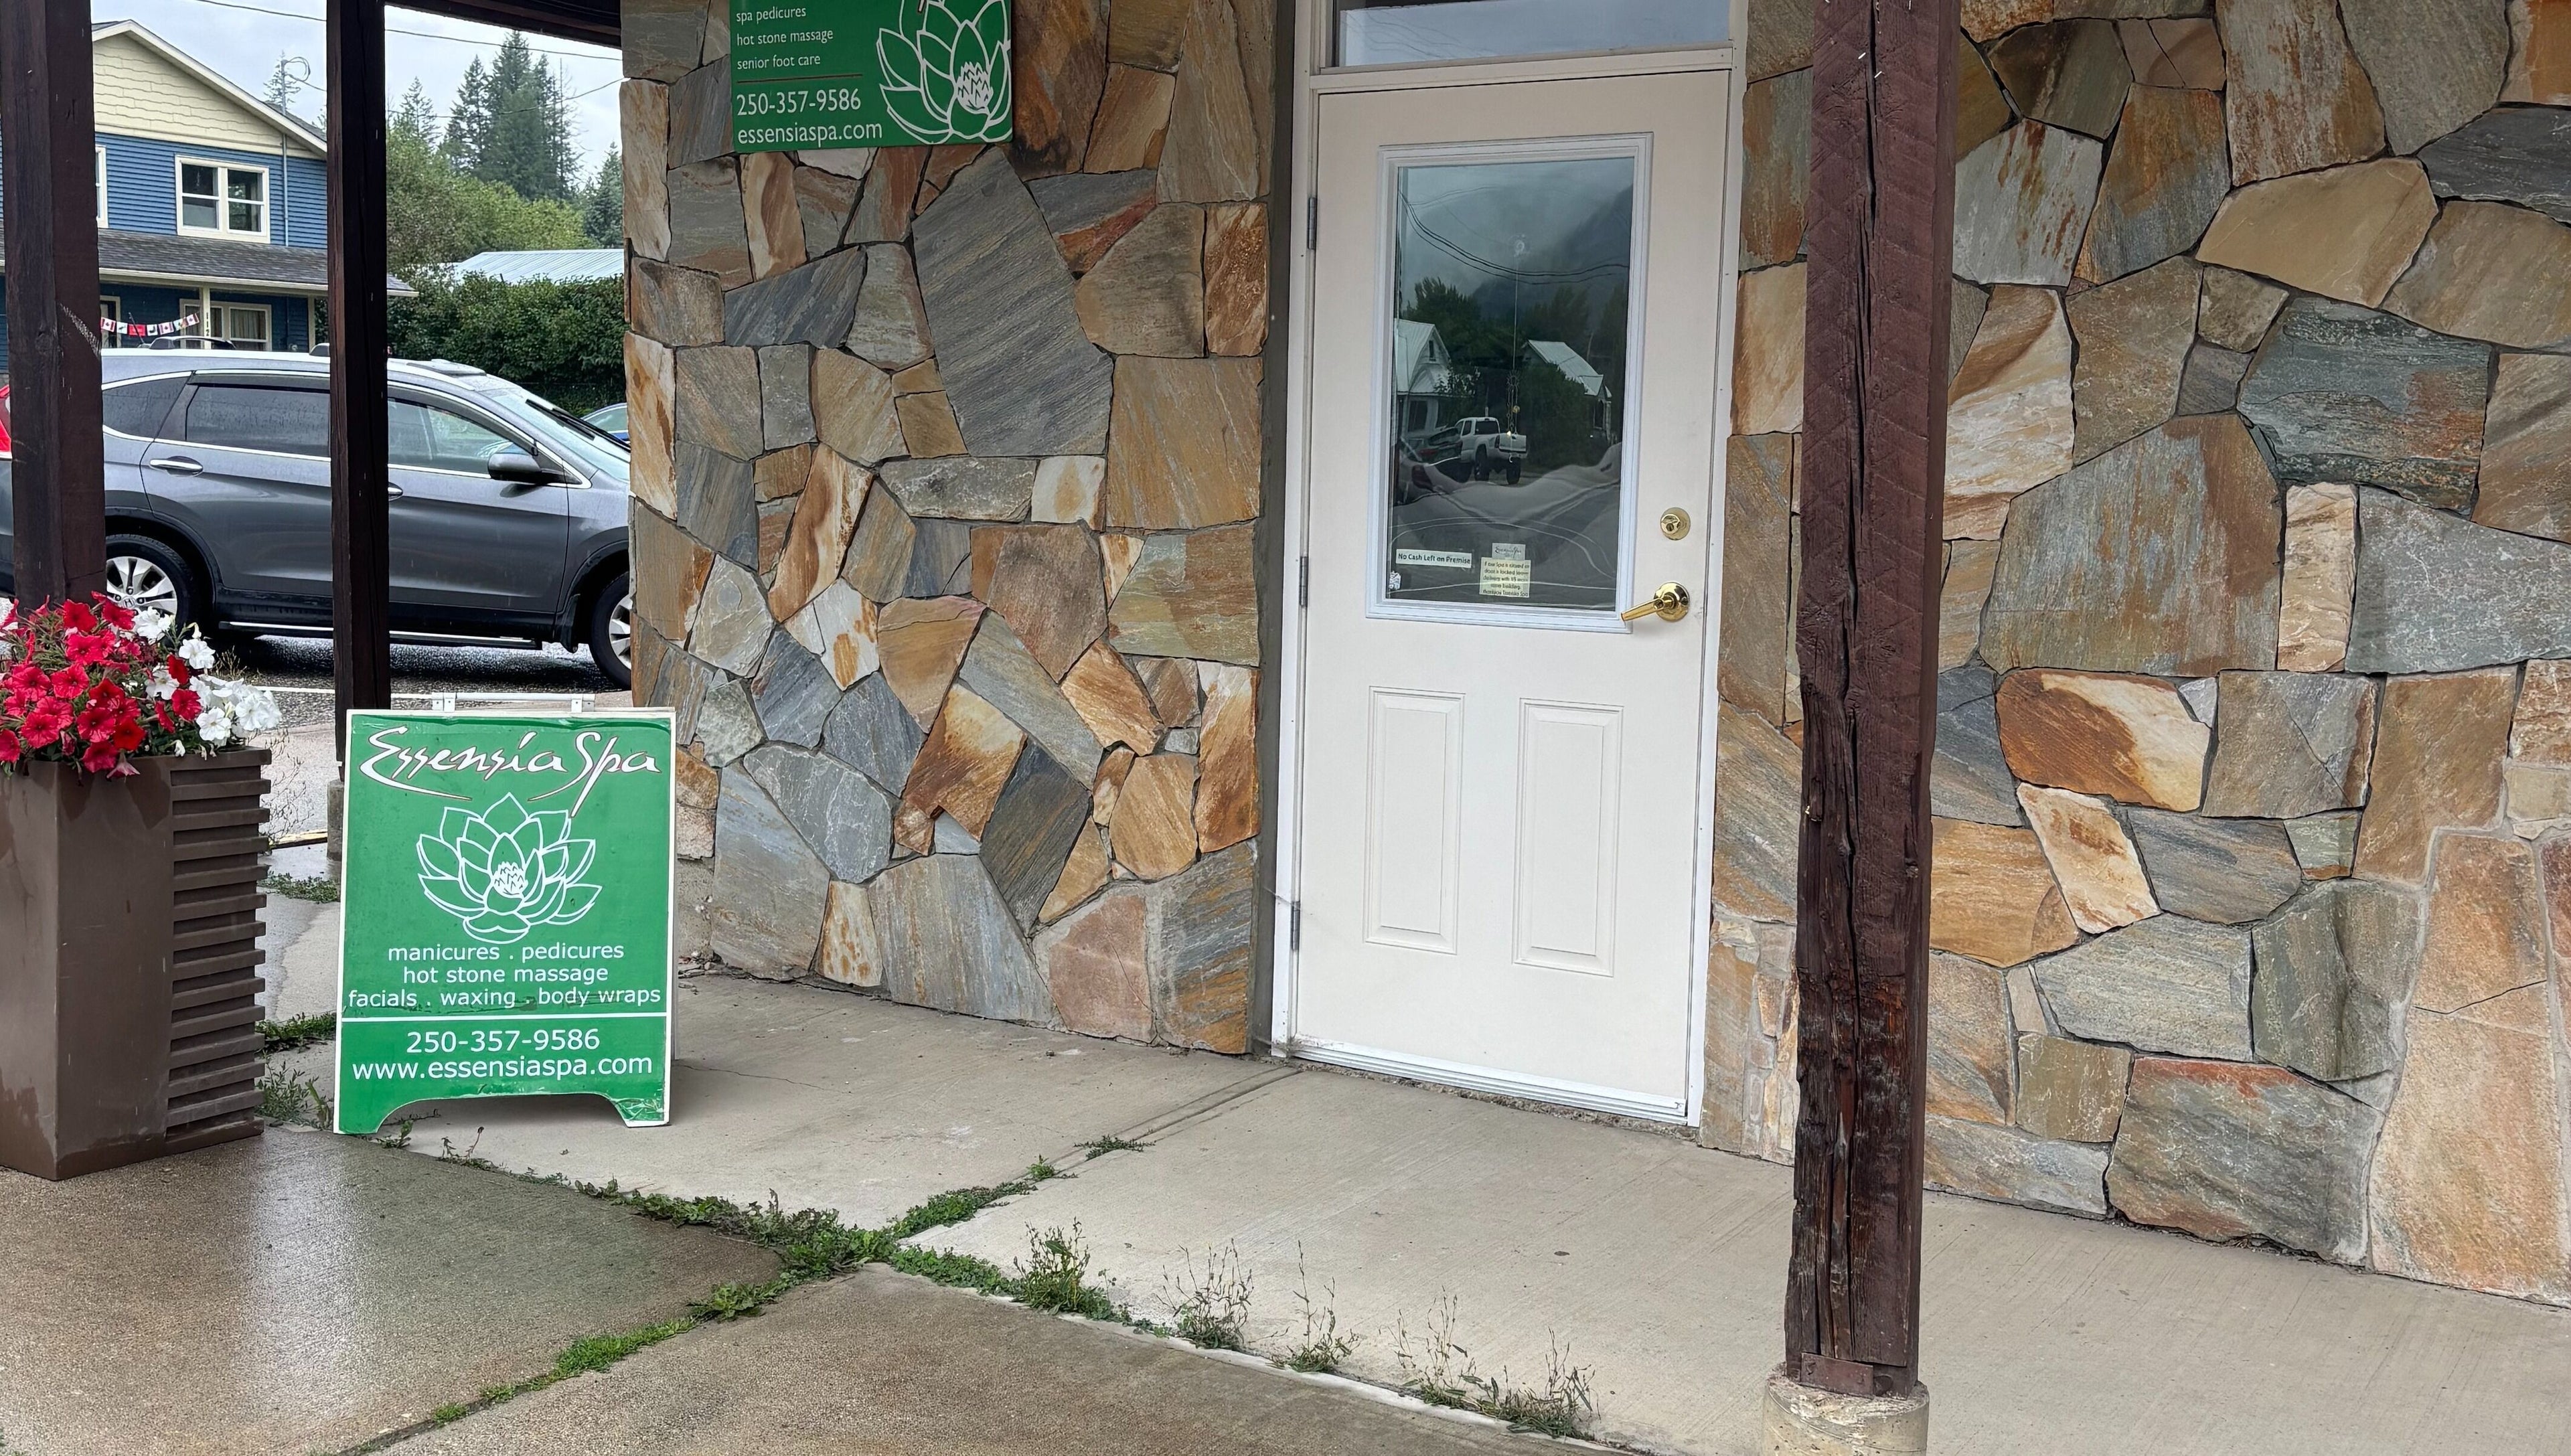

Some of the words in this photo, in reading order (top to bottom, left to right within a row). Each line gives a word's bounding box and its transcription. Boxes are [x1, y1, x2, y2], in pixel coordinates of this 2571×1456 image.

[736, 12, 753, 25] spa
[756, 6, 806, 25] pedicures
[736, 33, 755, 46] hot
[757, 33, 787, 45] stone
[790, 30, 834, 44] massage
[736, 56, 770, 70] senior
[773, 54, 795, 68] foot
[797, 56, 821, 66] care
[736, 88, 862, 116] 250-357-9586
[738, 122, 882, 148] essensiaspa.com
[1446, 556, 1470, 564] Premise
[360, 726, 568, 801] Essensia
[528, 731, 661, 818] Spa
[388, 943, 500, 961] manicures
[522, 941, 624, 963] pedicures
[404, 966, 439, 983] hot
[446, 967, 505, 983] stone
[514, 967, 609, 985] massage
[348, 989, 417, 1007] facials
[440, 988, 516, 1009] waxing
[538, 987, 590, 1007] body
[598, 989, 661, 1007] wraps
[406, 1028, 600, 1053] 250-357-9586
[352, 1055, 652, 1081] www.essensiaspa.com
